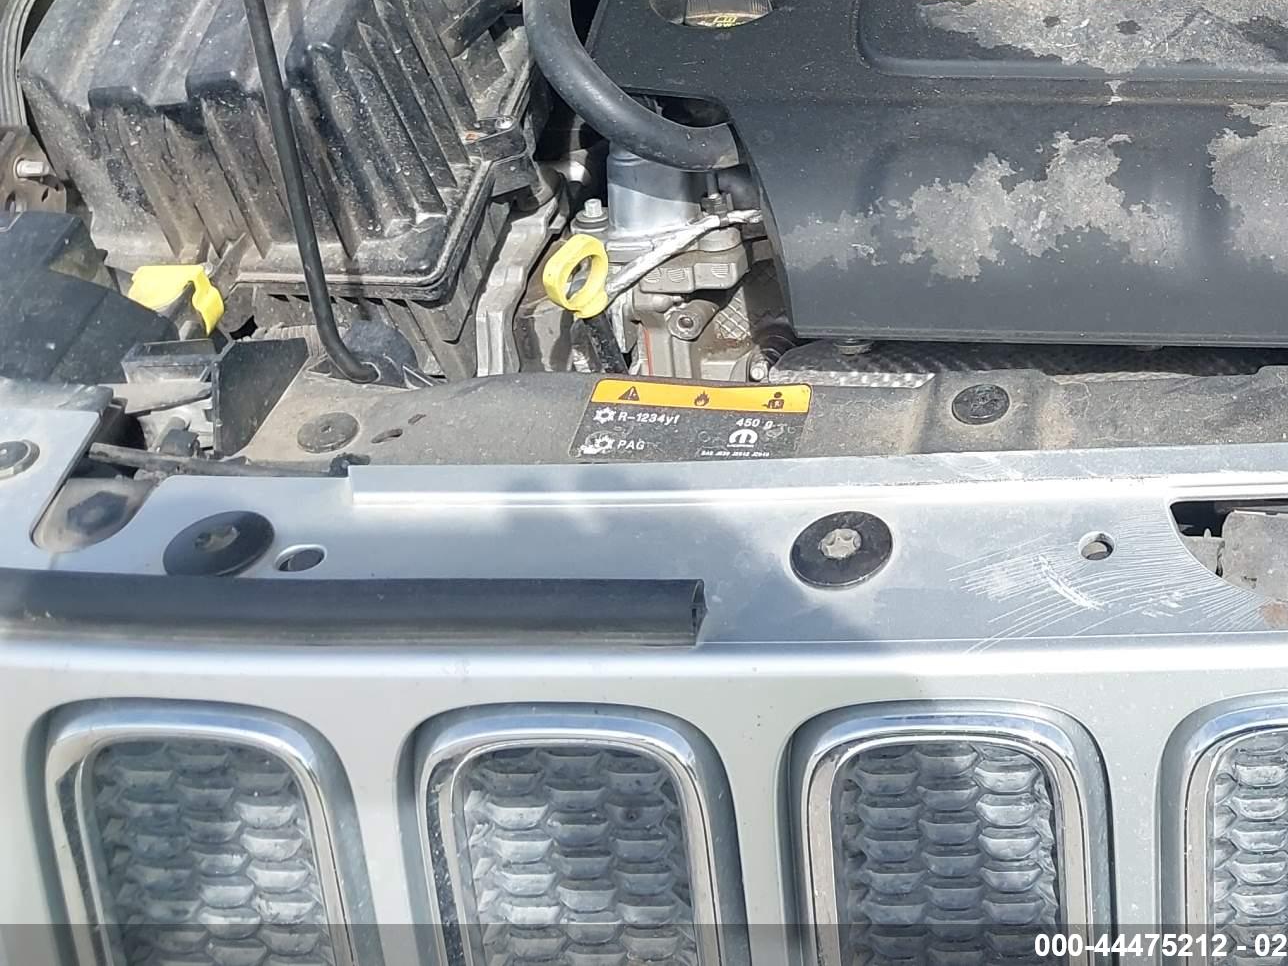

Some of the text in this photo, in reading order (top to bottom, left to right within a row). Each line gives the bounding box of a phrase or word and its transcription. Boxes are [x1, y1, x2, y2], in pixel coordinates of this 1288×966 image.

[618, 412, 680, 425] R-1234yf
[736, 418, 760, 428] 450
[617, 440, 645, 451] PAG
